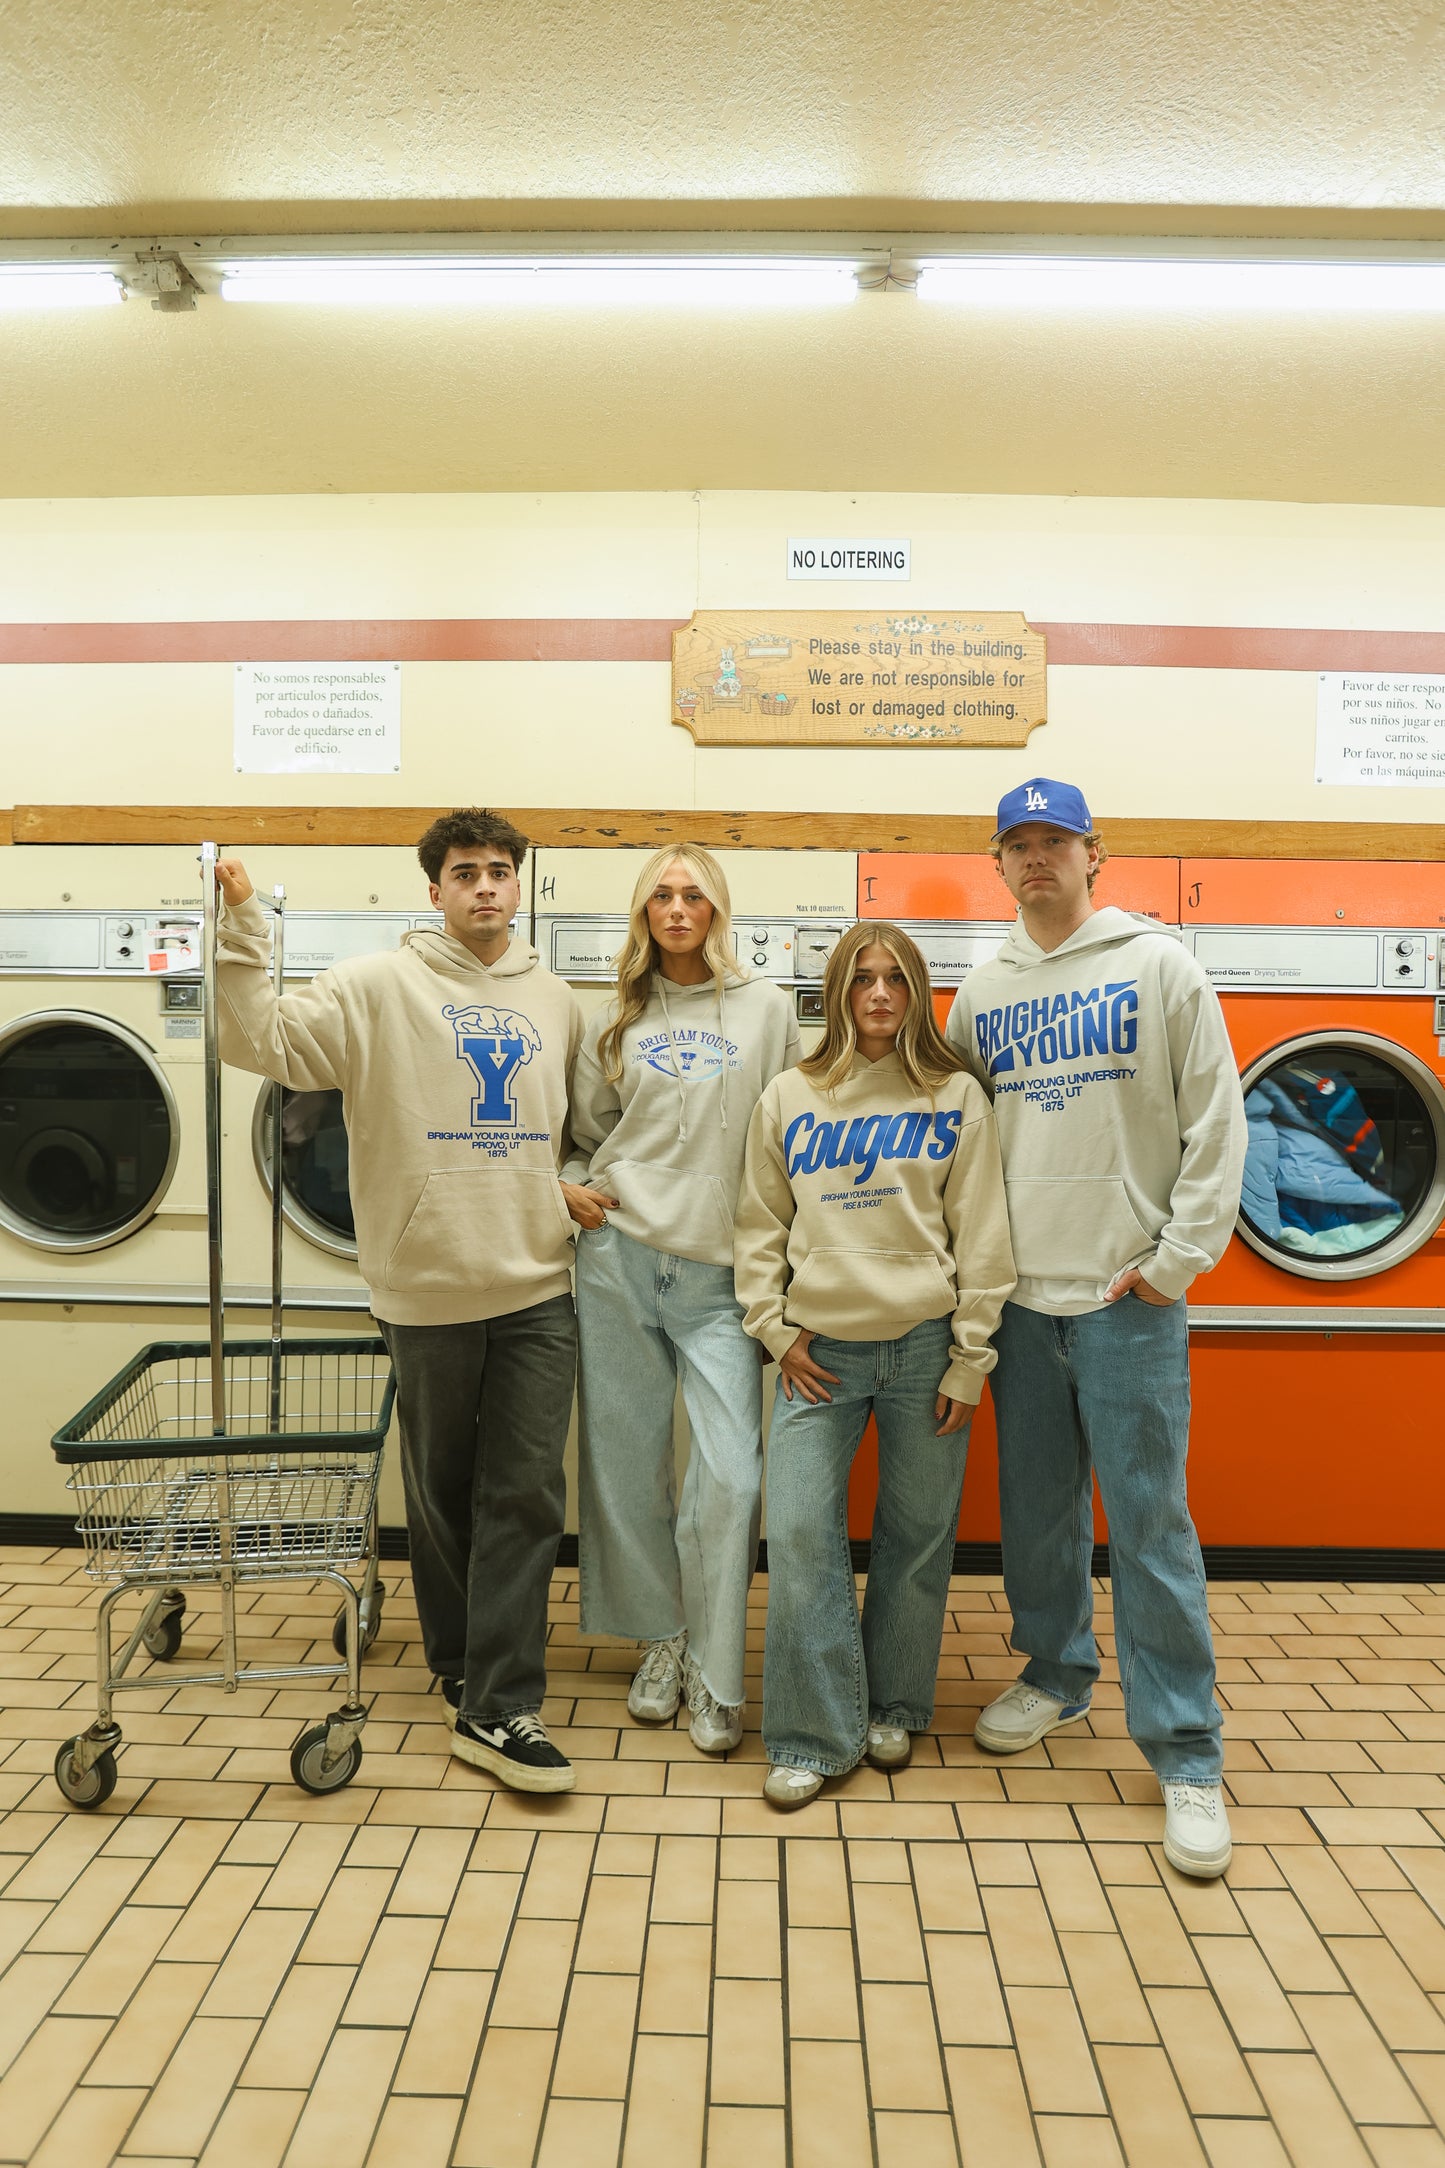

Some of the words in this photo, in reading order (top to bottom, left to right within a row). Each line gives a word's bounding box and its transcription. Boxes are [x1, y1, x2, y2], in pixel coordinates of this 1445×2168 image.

[793, 550, 816, 569] NO
[821, 550, 906, 569] LOITERING
[809, 638, 861, 655] Please
[869, 640, 902, 659] stay
[909, 639, 923, 656] in
[931, 639, 955, 656] the
[963, 640, 1027, 660] building.
[253, 672, 271, 684] No
[273, 674, 311, 684] somos
[313, 672, 387, 687] responsables
[808, 668, 832, 686] We
[839, 671, 864, 686] are
[872, 670, 897, 686] not
[905, 669, 995, 690] responsible
[1003, 670, 1025, 687] for
[1342, 680, 1374, 691] Favor
[1377, 680, 1390, 691] de
[1393, 683, 1409, 692] ser
[255, 691, 275, 704] por
[330, 689, 383, 704] perdidos,
[812, 698, 841, 715] lost
[849, 701, 865, 715] or
[872, 699, 945, 720] damaged
[953, 700, 1019, 720] clothing.
[1343, 699, 1362, 711] por
[1364, 700, 1382, 708] sus
[1386, 698, 1418, 710] niños.
[1425, 698, 1442, 710] No
[264, 707, 309, 719] robados
[312, 709, 320, 719] o
[323, 707, 373, 719] dañados.
[1349, 716, 1367, 725] sus
[1370, 715, 1400, 725] niños
[1402, 715, 1431, 729] jugar
[252, 724, 285, 737] Favor
[287, 724, 301, 737] de
[357, 727, 372, 737] en
[375, 725, 386, 737] el
[1385, 732, 1429, 744] carritos.
[294, 742, 341, 754] edificio.
[1343, 747, 1362, 758] Por
[1366, 748, 1396, 760] favor,
[1399, 752, 1413, 760] no
[1416, 752, 1428, 760] se
[1360, 766, 1373, 776] en
[1377, 765, 1392, 776] las
[1395, 766, 1445, 780] máquinas
[1025, 786, 1048, 812] LA
[540, 876, 555, 901] H
[863, 876, 878, 903] I
[1188, 882, 1203, 908] J
[796, 904, 809, 912] Max
[810, 904, 817, 912] 10
[288, 954, 309, 962] Drying
[929, 961, 973, 970] Originators
[1254, 969, 1275, 977] Drying
[1277, 969, 1301, 977] Tumbler
[975, 987, 1100, 1072] BRIGHAM
[1015, 989, 1138, 1067] YOUNG
[636, 1053, 671, 1062] COUGARS
[456, 1032, 525, 1127] Y
[1028, 1076, 1065, 1090] YOUNG
[1067, 1068, 1137, 1085] UNIVERSITY
[1025, 1088, 1064, 1102] PROVO,
[1065, 1085, 1083, 1097] UT
[1040, 1101, 1065, 1112] 1875
[427, 1131, 473, 1141] BRIGHAM
[475, 1132, 510, 1141] YOUNG
[472, 1141, 508, 1151] PROVO,
[509, 1141, 521, 1150] UT
[784, 1109, 963, 1186] Cougars
[487, 1150, 508, 1158] 1875
[820, 1192, 849, 1203] BRIGHAM
[849, 1190, 870, 1200] YOUNG
[871, 1187, 903, 1198] UNIVERSITY
[842, 1201, 857, 1210] RISE
[857, 1201, 862, 1209] &
[862, 1199, 883, 1209] SHOUT
